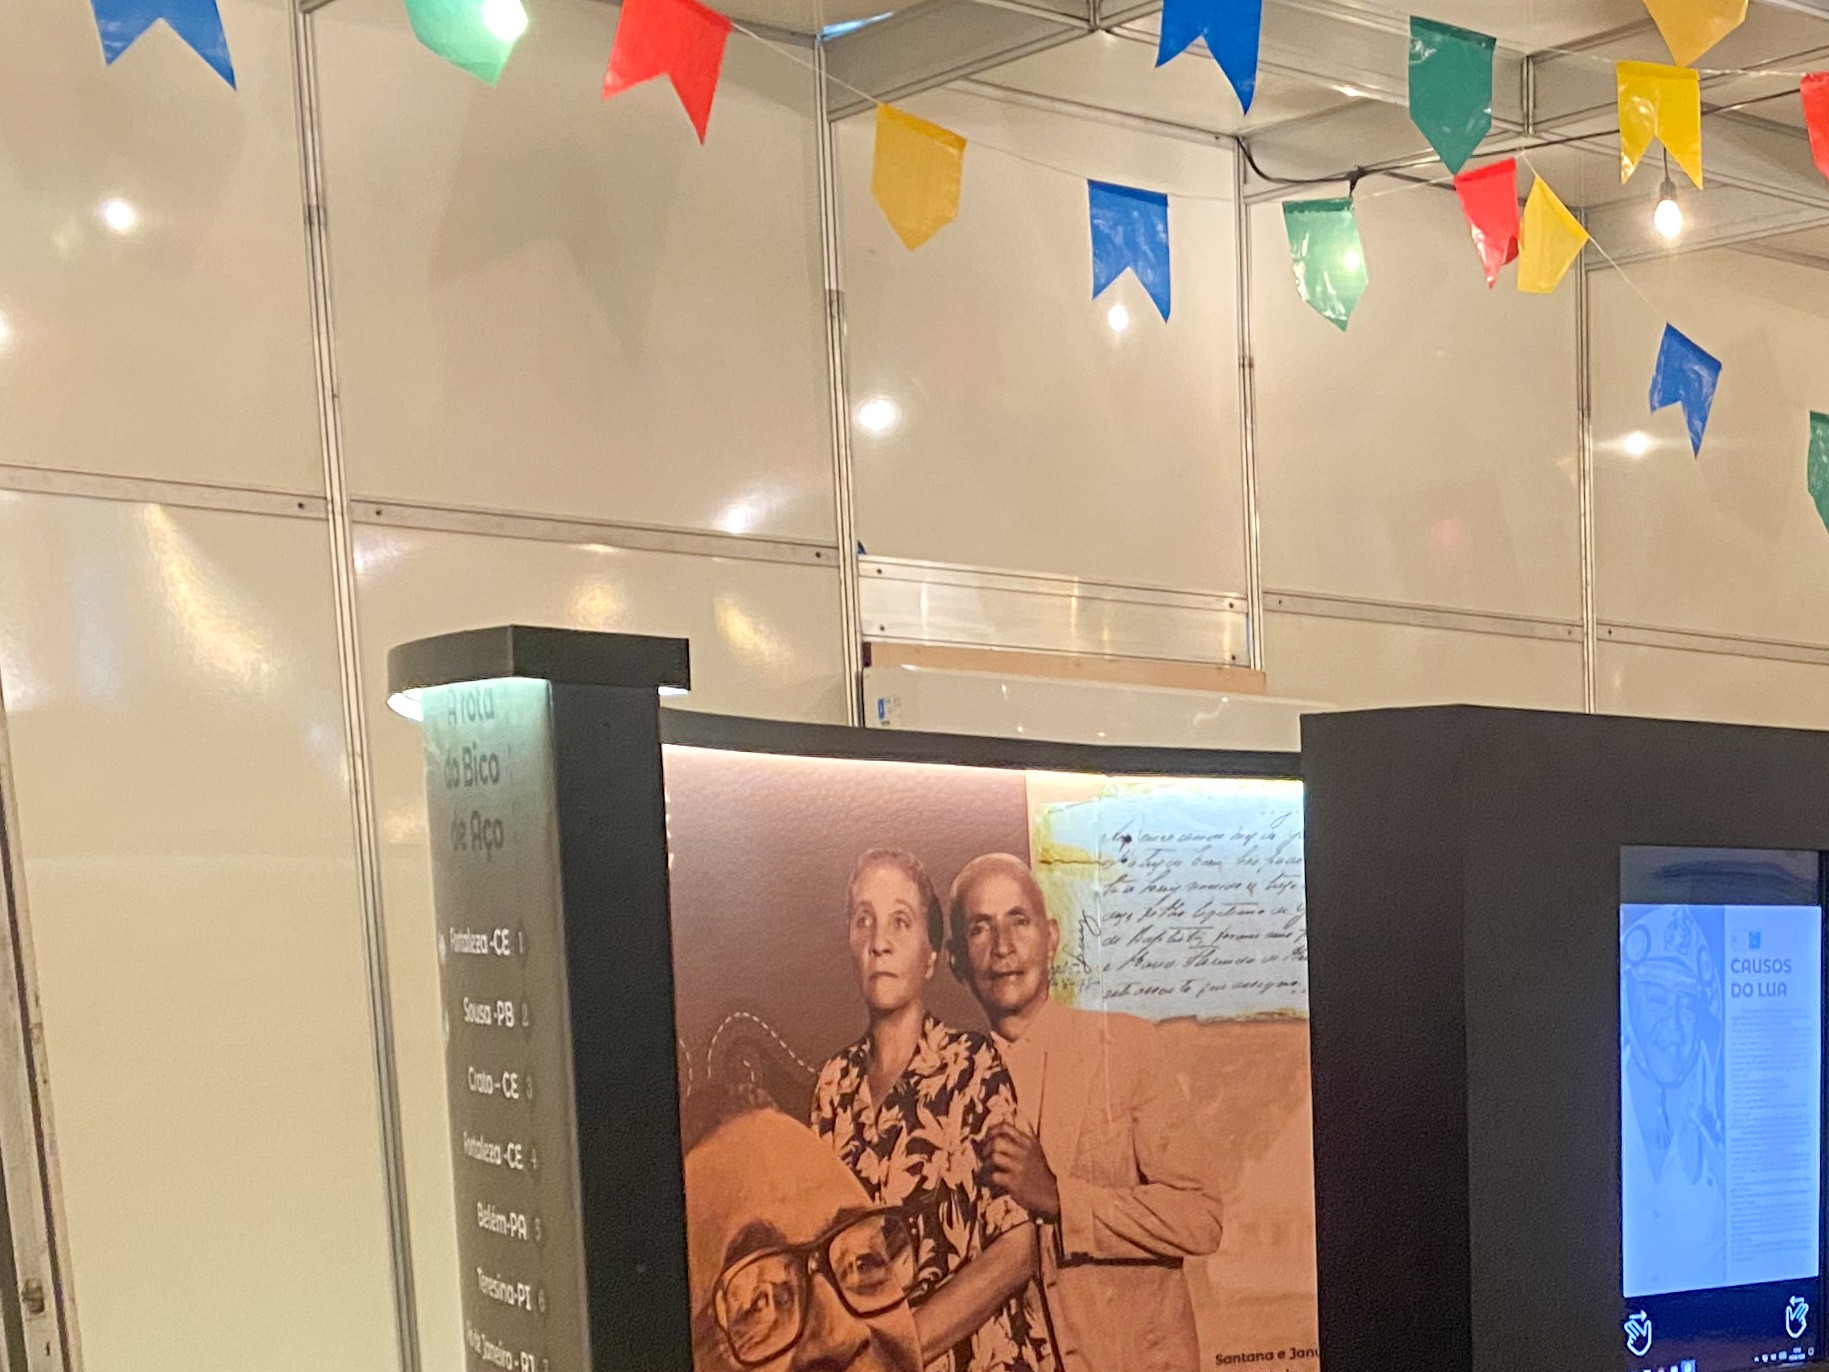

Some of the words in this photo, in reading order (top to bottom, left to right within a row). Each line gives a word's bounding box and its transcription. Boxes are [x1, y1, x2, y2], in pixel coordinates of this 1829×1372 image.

[460, 686, 495, 723] rota
[462, 742, 499, 788] Bico
[470, 810, 504, 862] Aço
[1731, 958, 1792, 973] CAUSOS
[1731, 982, 1753, 998] DO
[1758, 982, 1787, 997] LUA
[463, 997, 492, 1026] Sousa
[468, 1066, 493, 1095] Crato
[502, 1071, 519, 1099] CE
[1216, 1351, 1274, 1366] Santana
[1277, 1350, 1286, 1360] e
